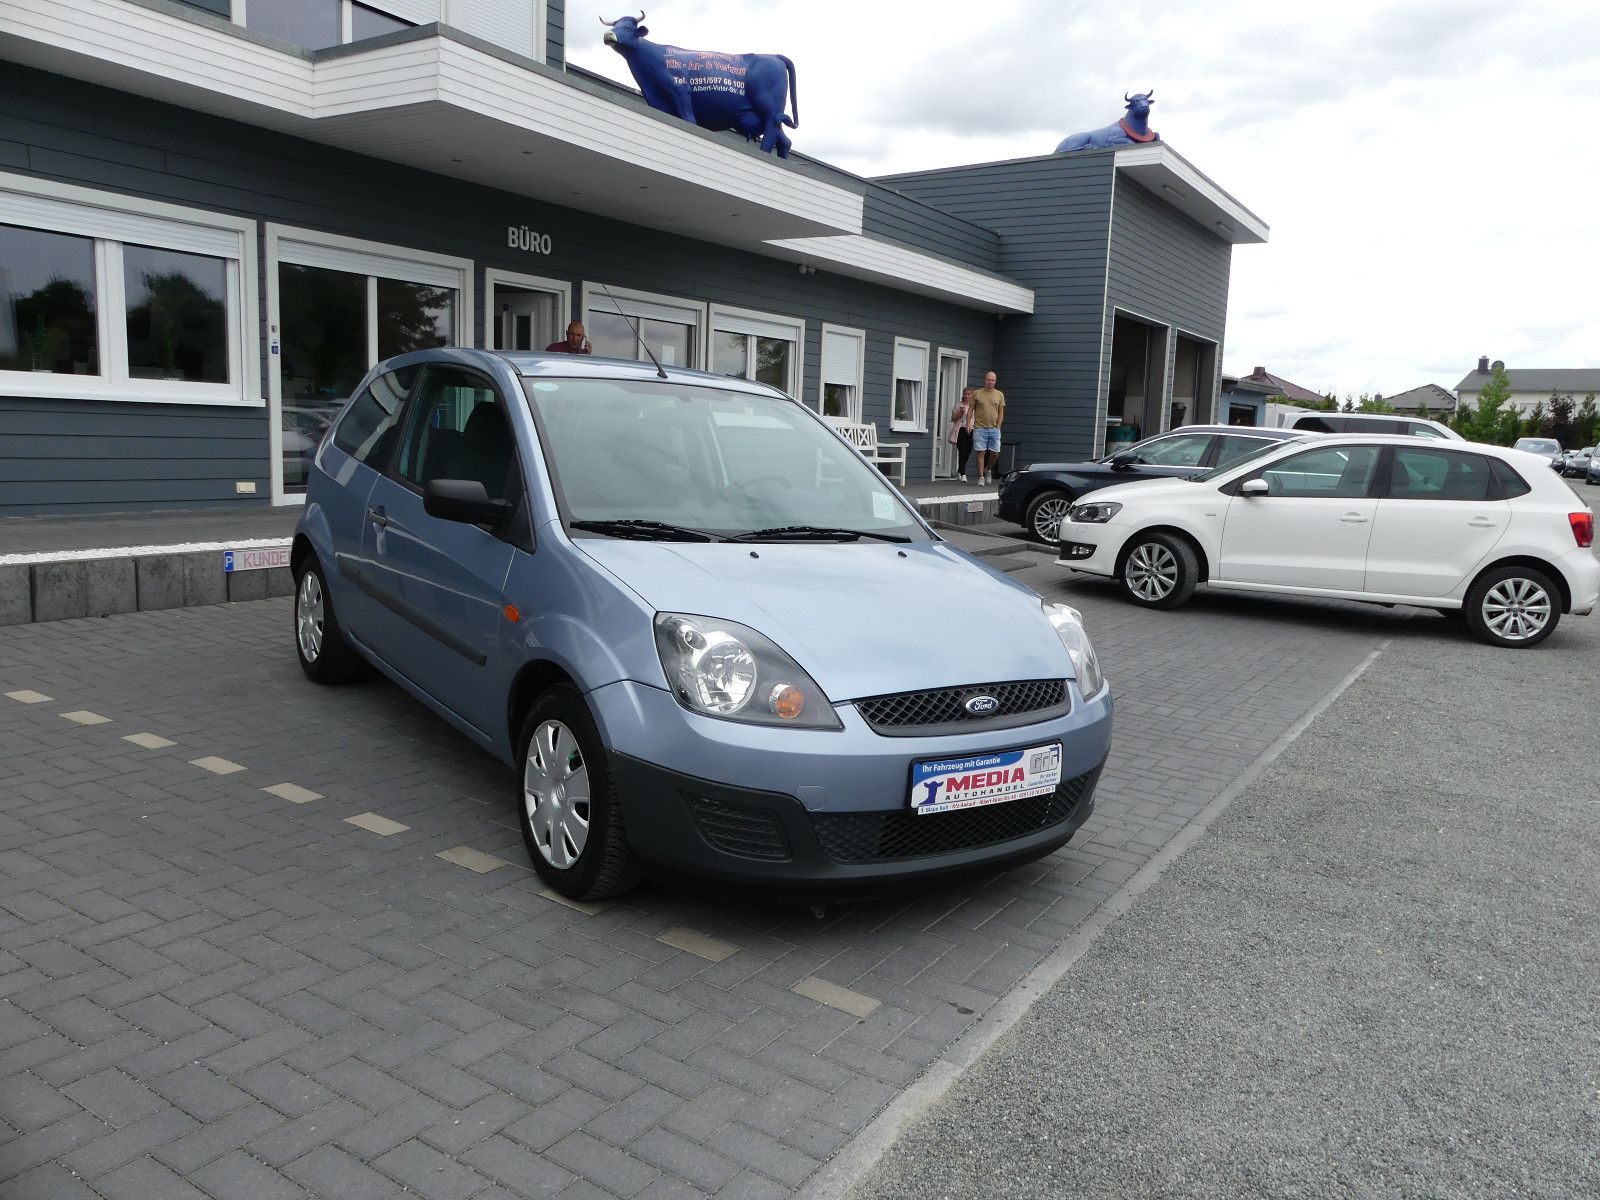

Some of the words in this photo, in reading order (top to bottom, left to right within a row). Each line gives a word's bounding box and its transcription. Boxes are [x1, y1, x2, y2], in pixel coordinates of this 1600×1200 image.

[673, 76, 688, 85] Tel.
[689, 76, 722, 85] 0391/597
[733, 80, 745, 89] 100
[508, 225, 552, 255] BÜRO
[226, 555, 233, 568] P
[243, 548, 292, 568] KUNDE
[974, 699, 993, 711] Ford
[922, 764, 932, 773] Ihr
[933, 762, 964, 772] Fahrzeug
[964, 760, 976, 769] mit
[976, 757, 1001, 768] Garantie
[945, 767, 1025, 793] MEDIA
[945, 783, 1025, 800] AUTOHANDEL
